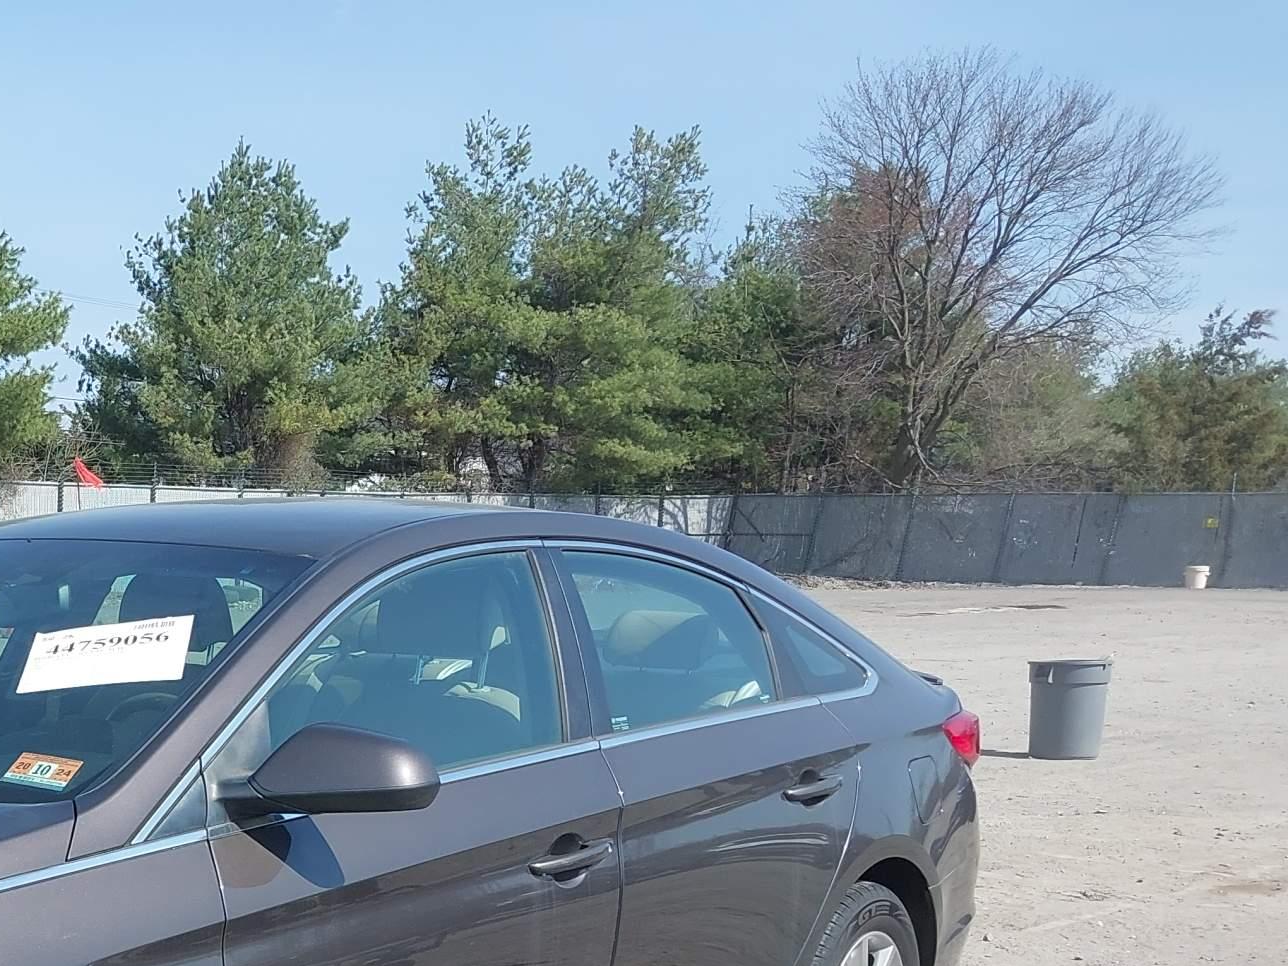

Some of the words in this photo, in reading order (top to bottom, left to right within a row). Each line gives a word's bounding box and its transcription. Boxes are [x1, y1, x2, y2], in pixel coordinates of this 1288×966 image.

[46, 631, 170, 655] 44759056
[15, 761, 32, 770] 20
[32, 763, 52, 776] 10
[55, 768, 72, 778] 24
